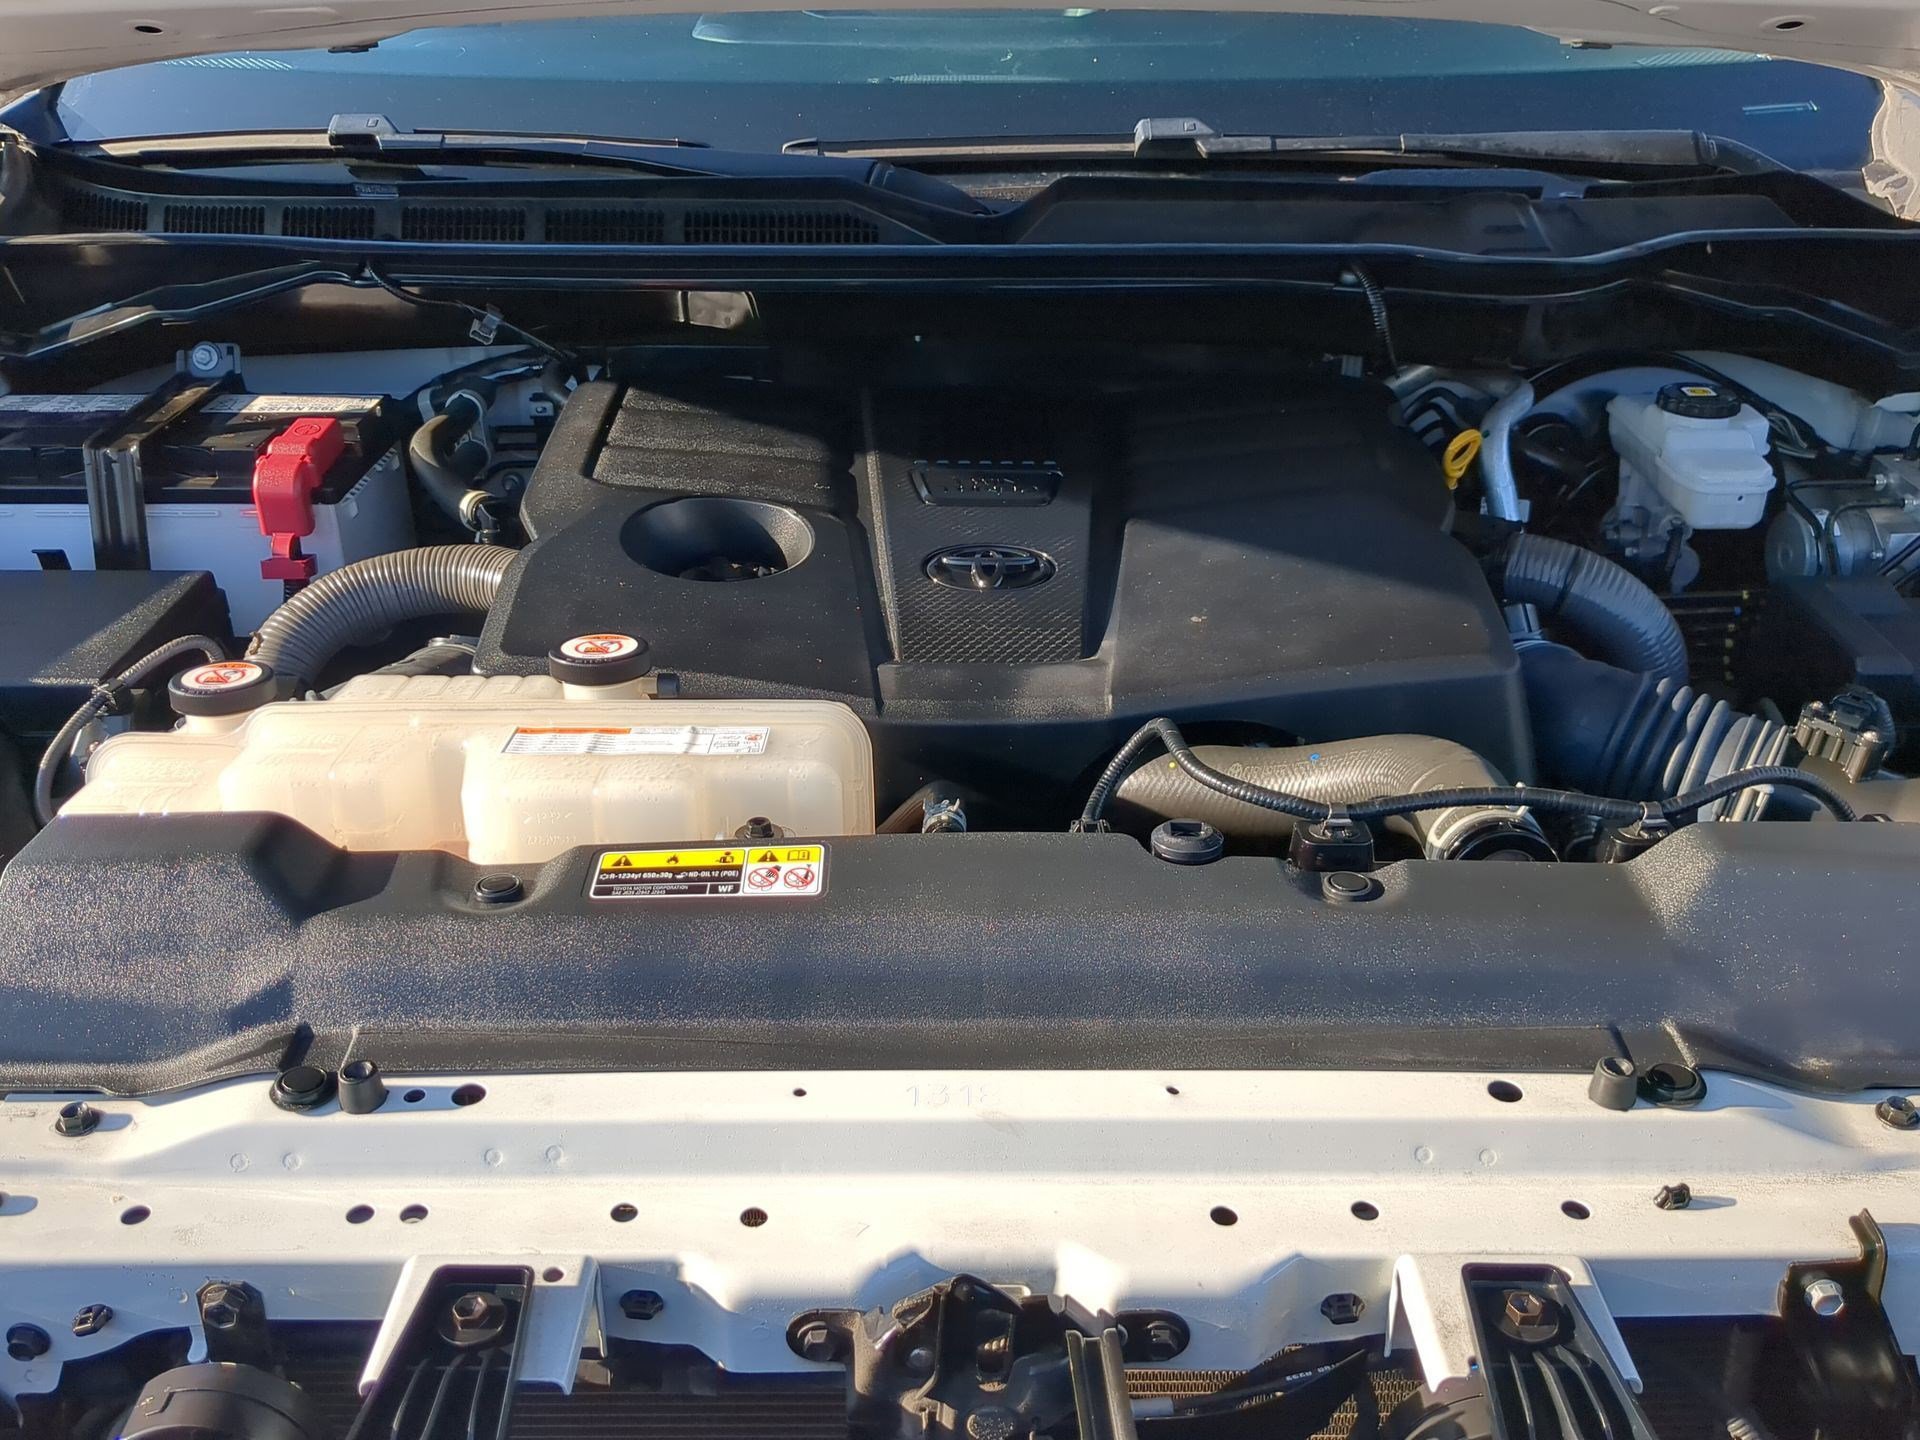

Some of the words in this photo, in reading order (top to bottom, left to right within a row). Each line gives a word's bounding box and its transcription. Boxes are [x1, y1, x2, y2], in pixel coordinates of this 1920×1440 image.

[609, 872, 641, 880] R-1234yf
[720, 870, 739, 878] (POE)
[718, 884, 734, 893] WF
